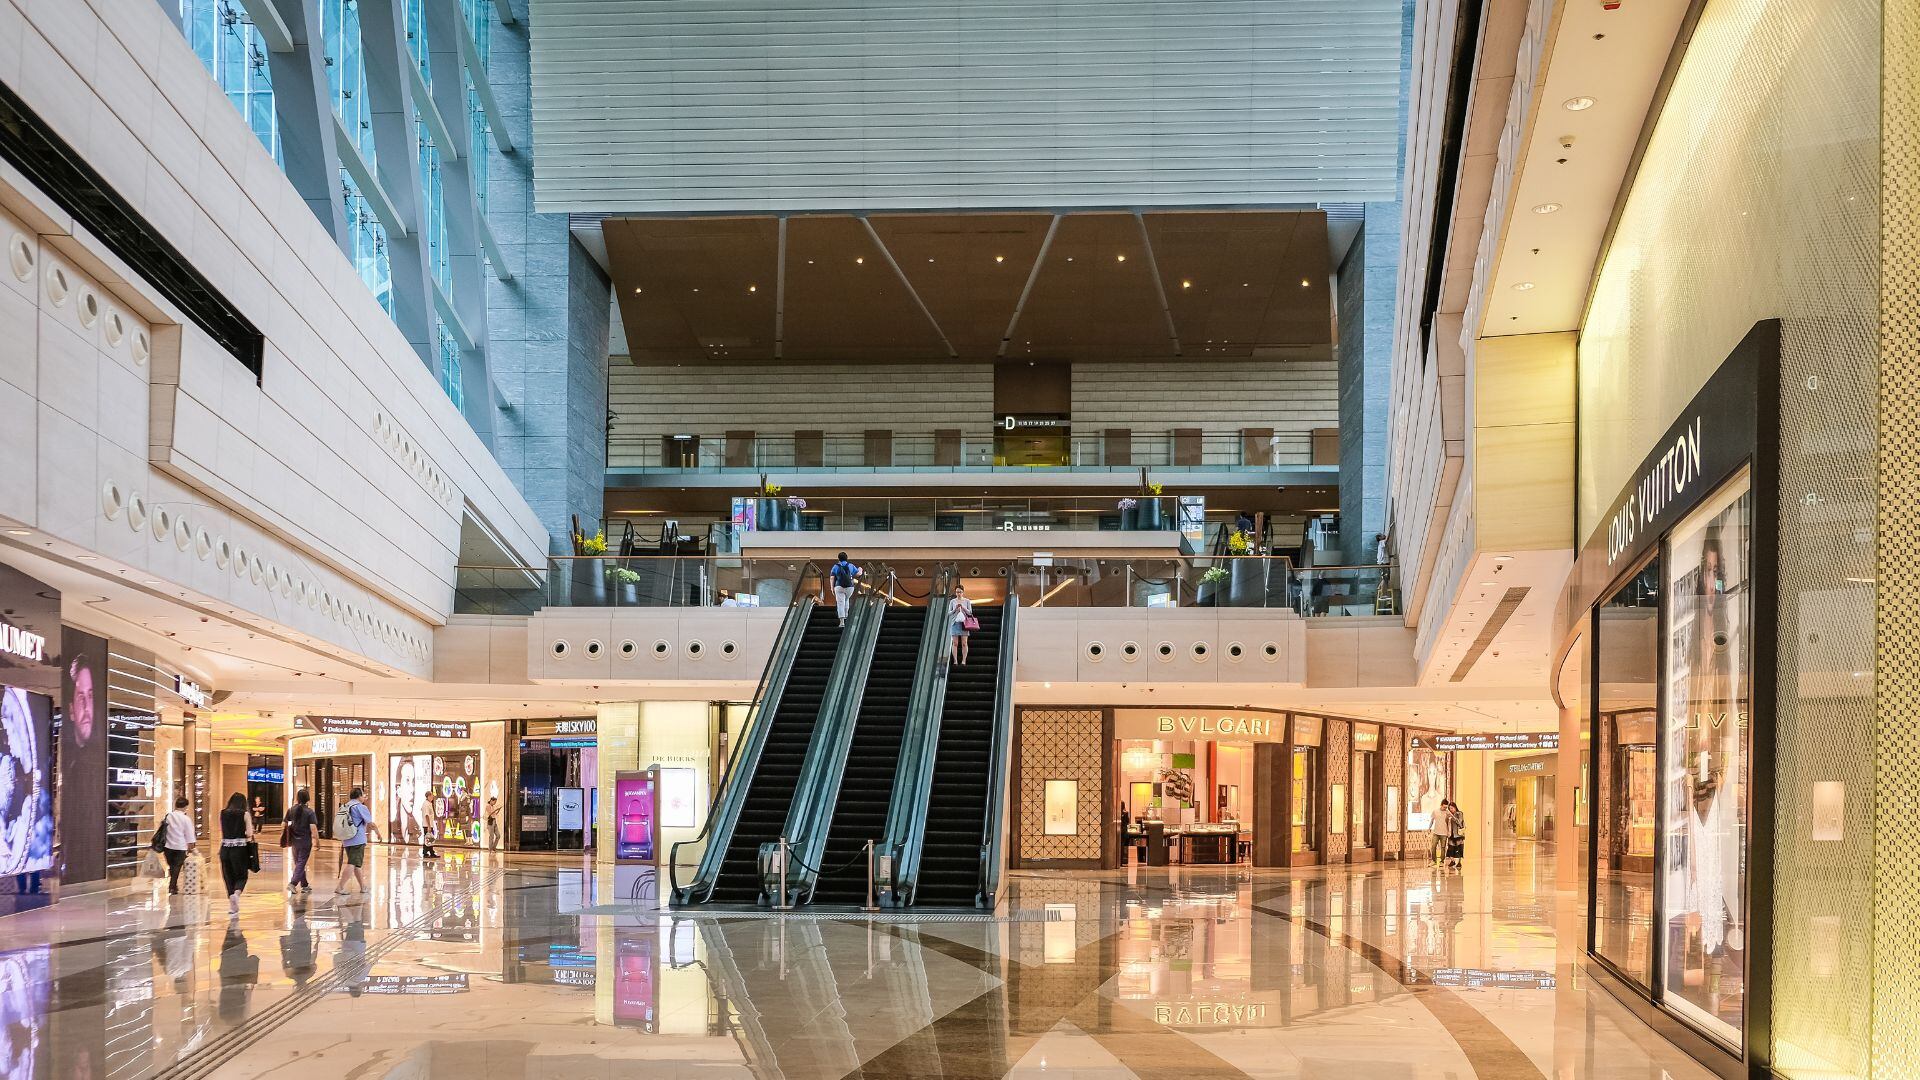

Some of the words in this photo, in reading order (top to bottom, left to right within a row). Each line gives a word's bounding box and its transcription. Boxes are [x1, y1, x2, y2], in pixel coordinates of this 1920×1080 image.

[1005, 416, 1016, 430] D
[1608, 494, 1635, 566] LOUIS
[1638, 415, 1701, 533] VUITTON
[0, 621, 45, 661] UMET
[571, 720, 596, 733] SKY100
[1158, 716, 1271, 736] BVLGARI
